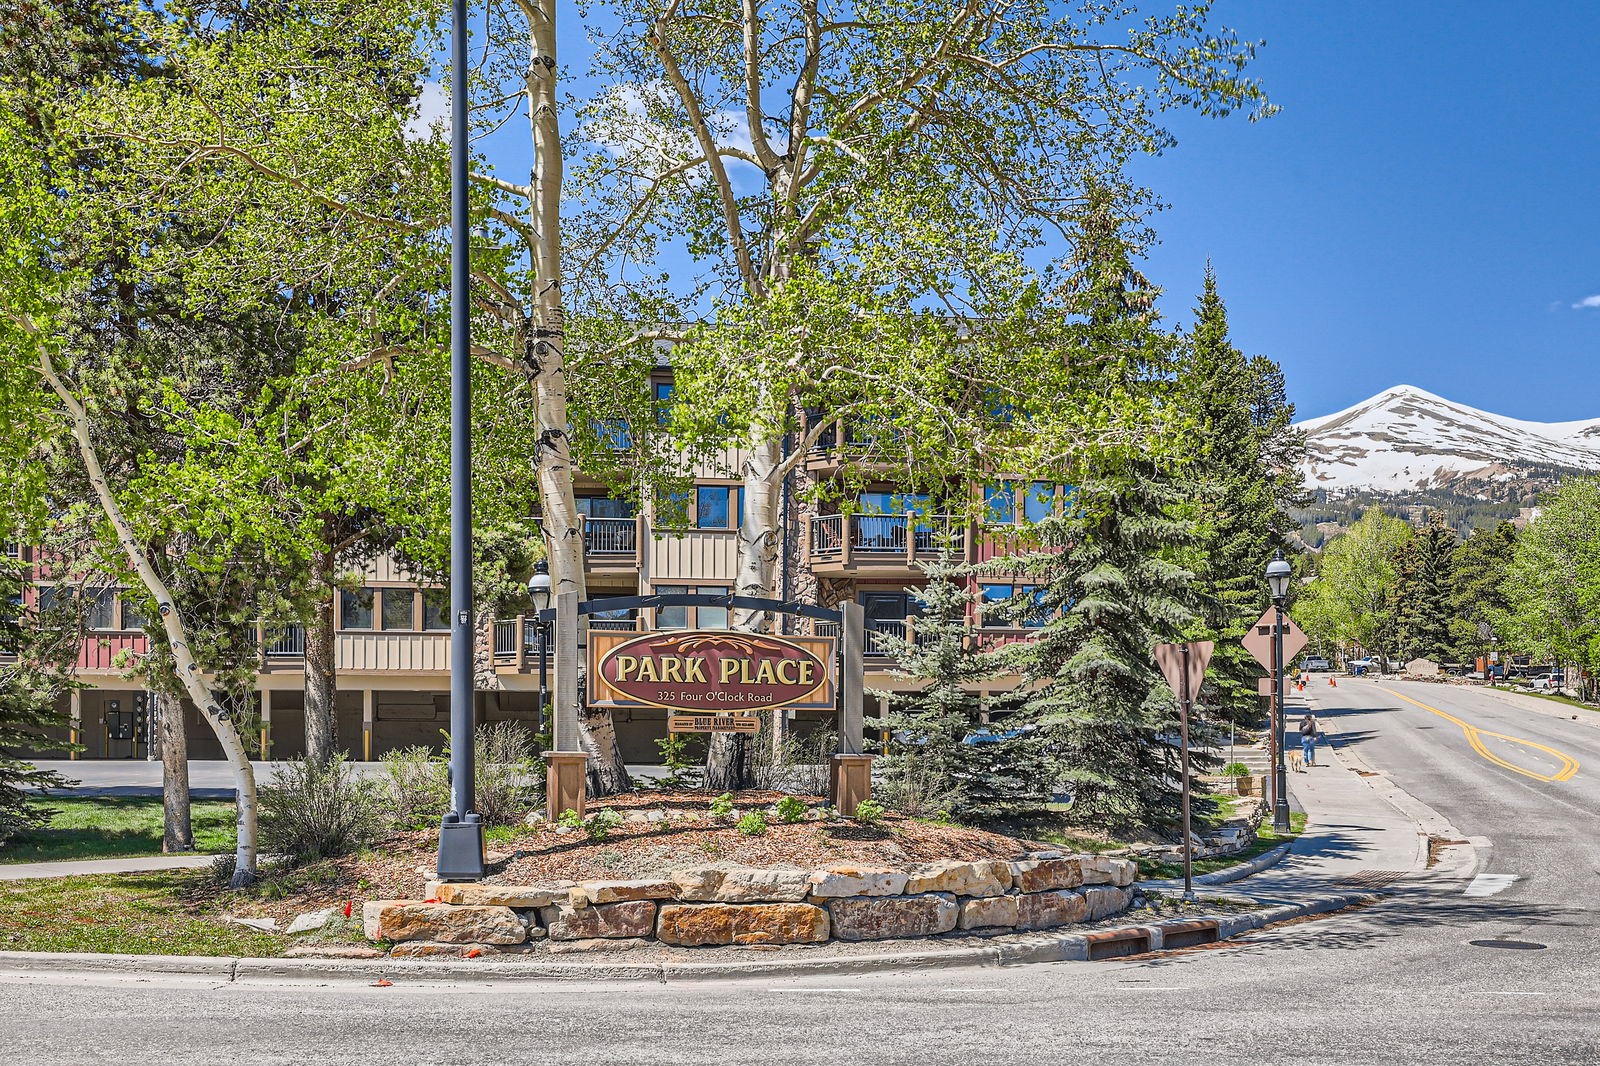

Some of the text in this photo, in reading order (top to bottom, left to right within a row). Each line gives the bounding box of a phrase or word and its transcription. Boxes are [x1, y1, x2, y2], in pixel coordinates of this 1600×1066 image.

[615, 655, 814, 685] PARK PLACE
[657, 691, 773, 702] 325 Four O'Clock Road
[694, 718, 712, 726] BLUE
[713, 718, 735, 726] RIVER
